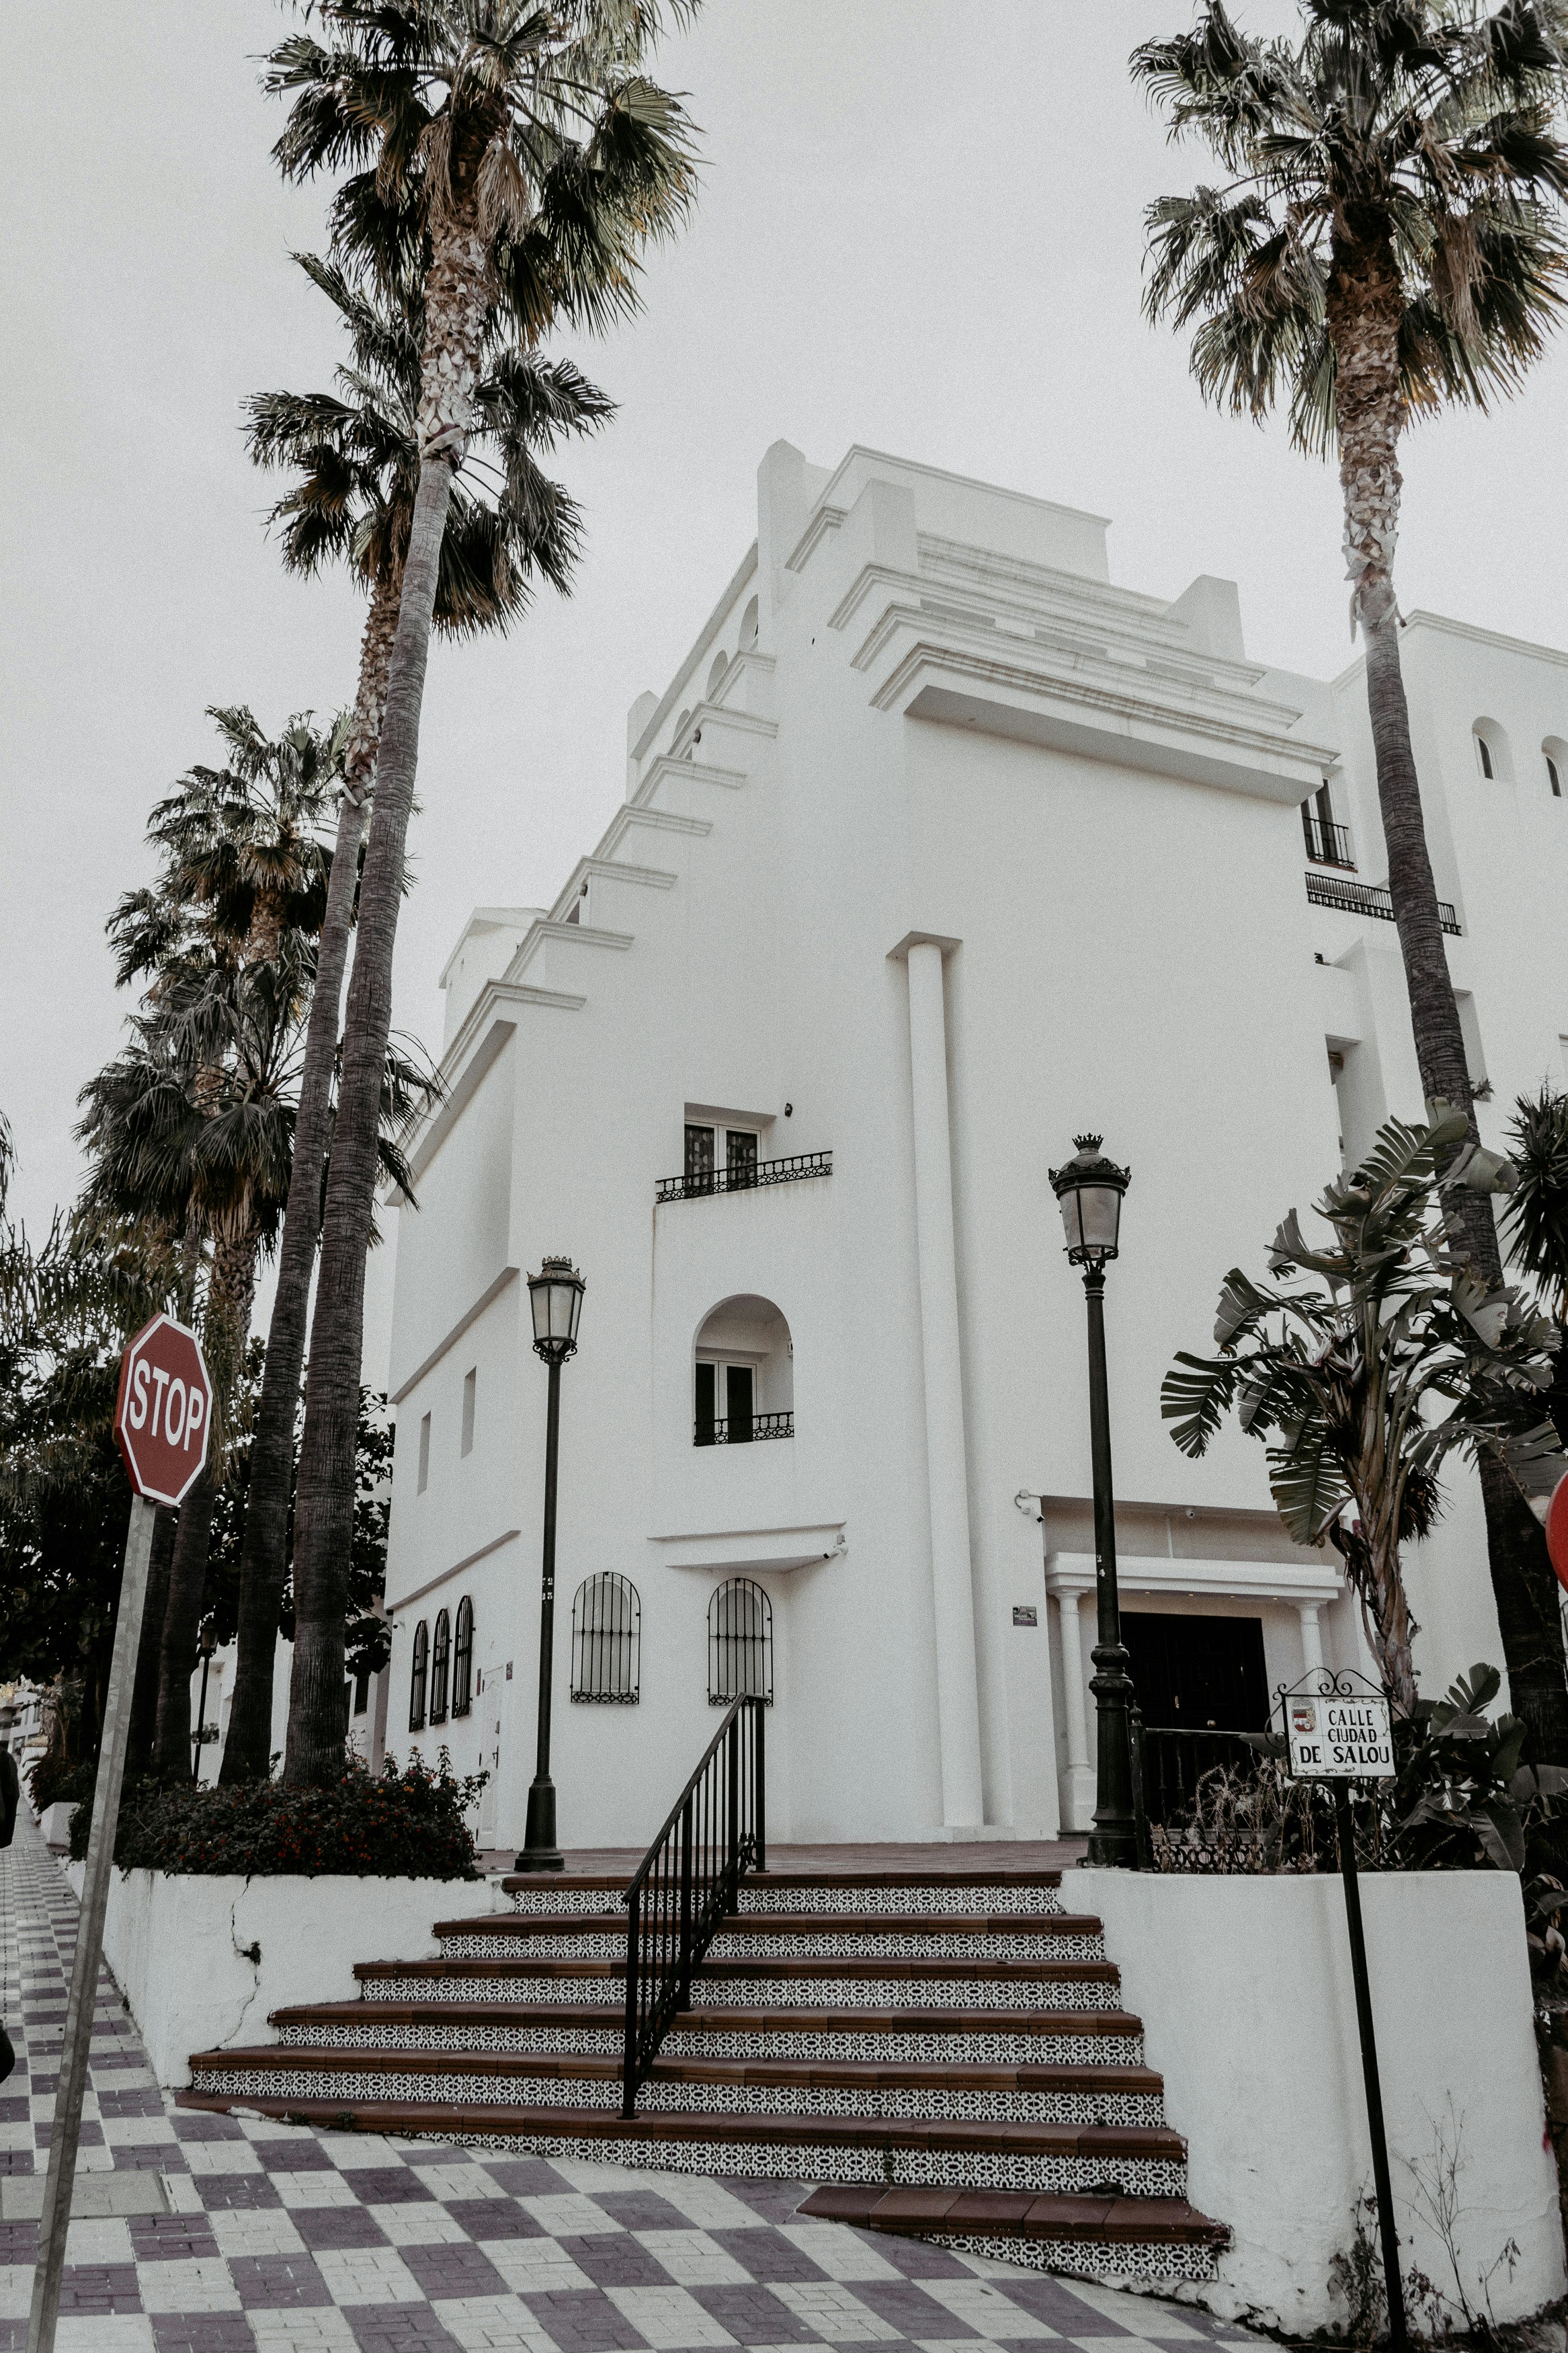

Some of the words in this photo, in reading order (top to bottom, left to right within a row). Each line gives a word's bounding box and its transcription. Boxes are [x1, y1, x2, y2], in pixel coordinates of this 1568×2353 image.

[130, 1359, 204, 1451] STOP
[1328, 1710, 1373, 1726] CALLE
[1327, 1728, 1377, 1743] CIUDAD
[1300, 1746, 1321, 1763] DE
[1333, 1746, 1390, 1763] SALOU
